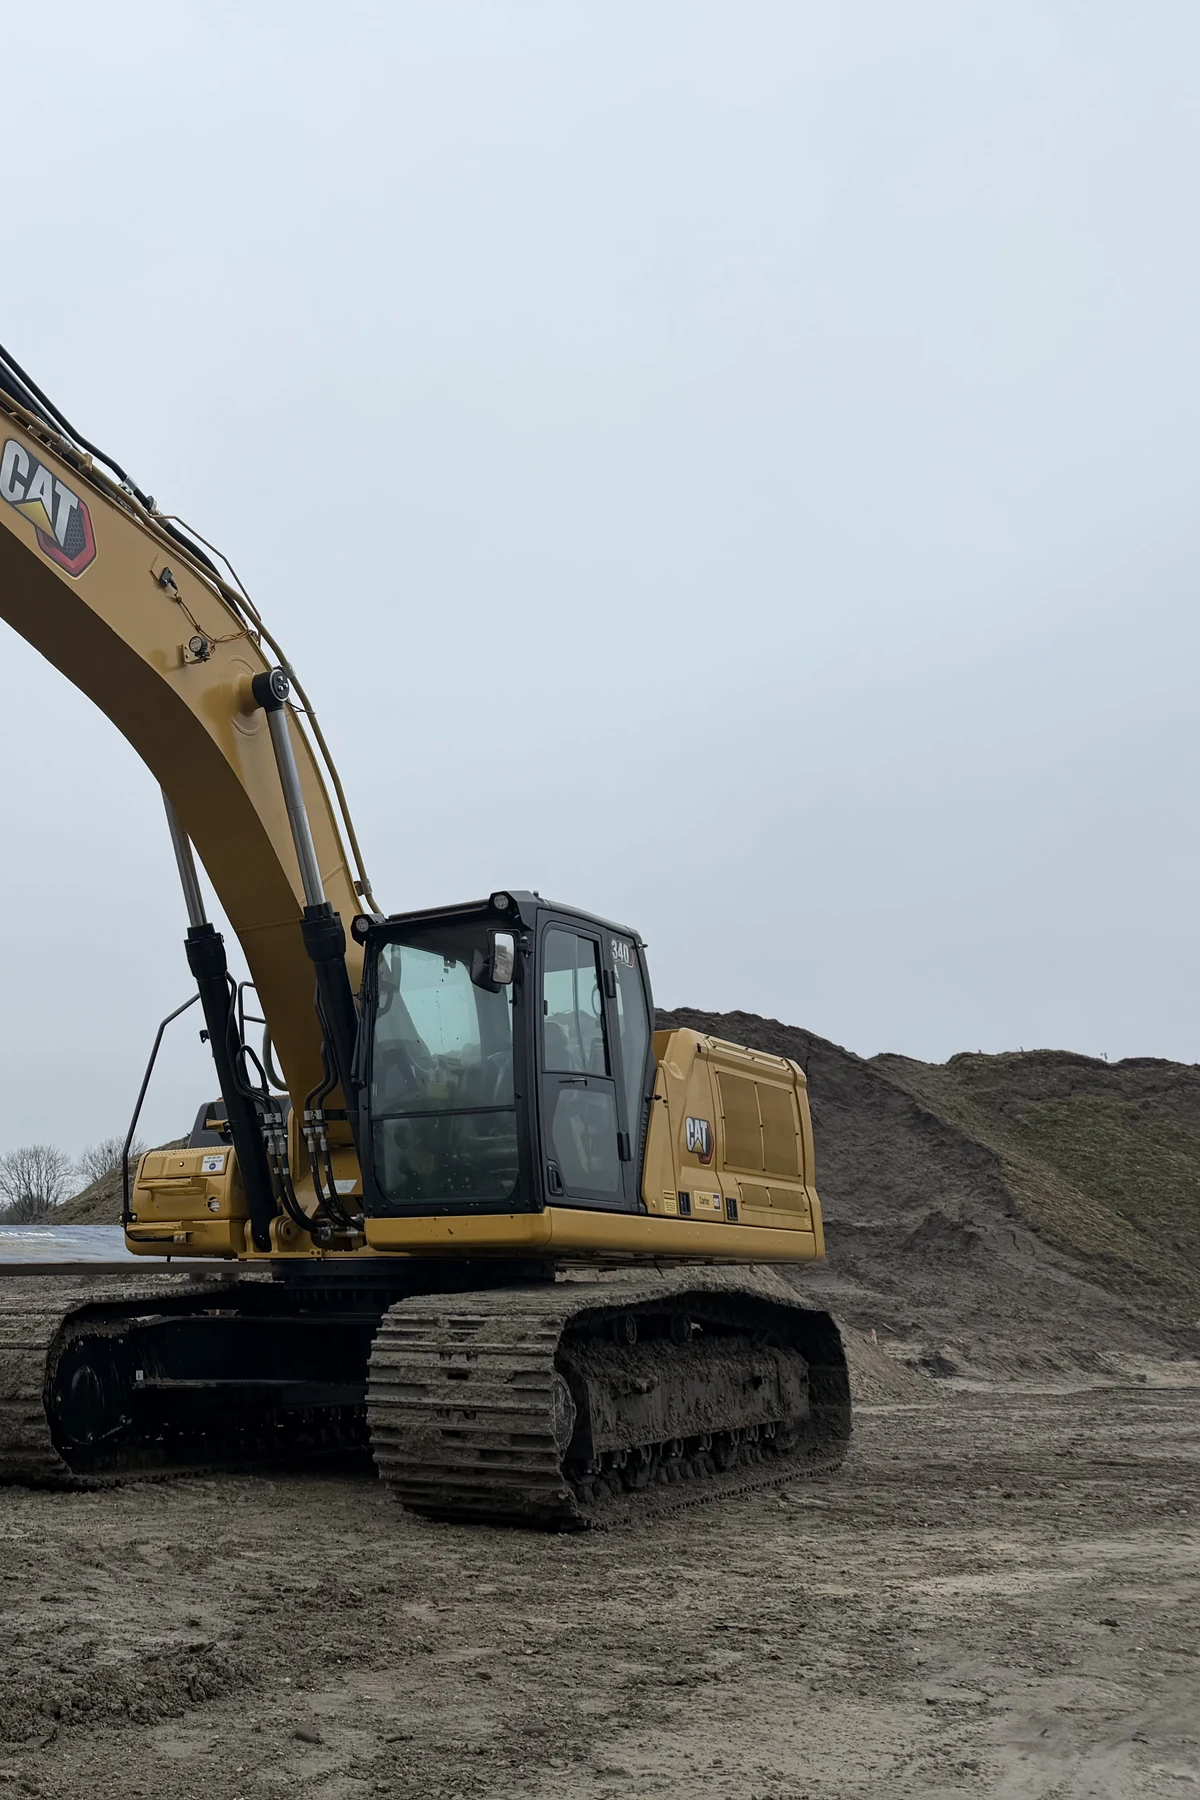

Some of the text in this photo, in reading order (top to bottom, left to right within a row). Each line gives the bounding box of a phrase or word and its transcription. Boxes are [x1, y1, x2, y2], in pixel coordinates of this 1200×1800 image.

[0, 439, 79, 548] CAT
[611, 939, 630, 965] 340
[686, 1117, 708, 1154] CAT
